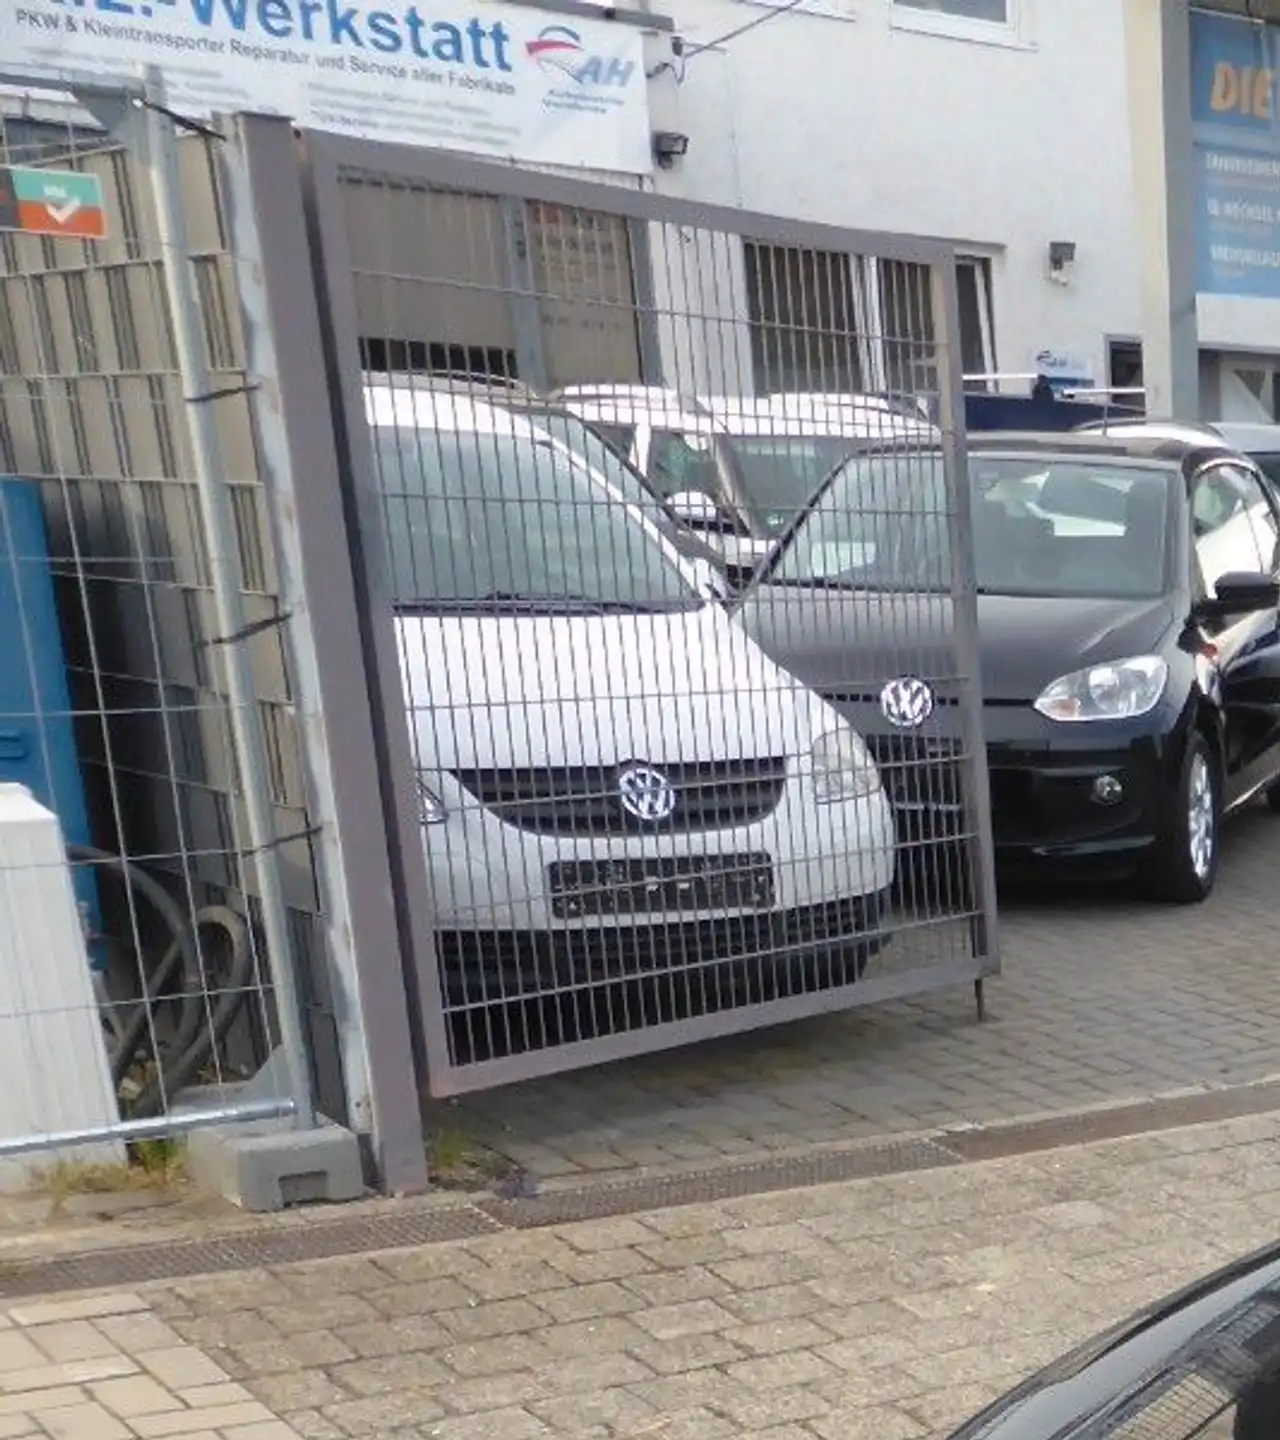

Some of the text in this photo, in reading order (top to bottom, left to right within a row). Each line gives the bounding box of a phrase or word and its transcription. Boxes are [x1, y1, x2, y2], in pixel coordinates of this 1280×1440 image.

[16, 8, 58, 30] PKW
[65, 15, 78, 33] &
[84, 18, 225, 56] Kleintransporter
[230, 38, 310, 64] Reparatur
[316, 52, 345, 70] und
[349, 53, 407, 80] Service
[575, 56, 634, 87] AH
[1209, 61, 1275, 119] DIE
